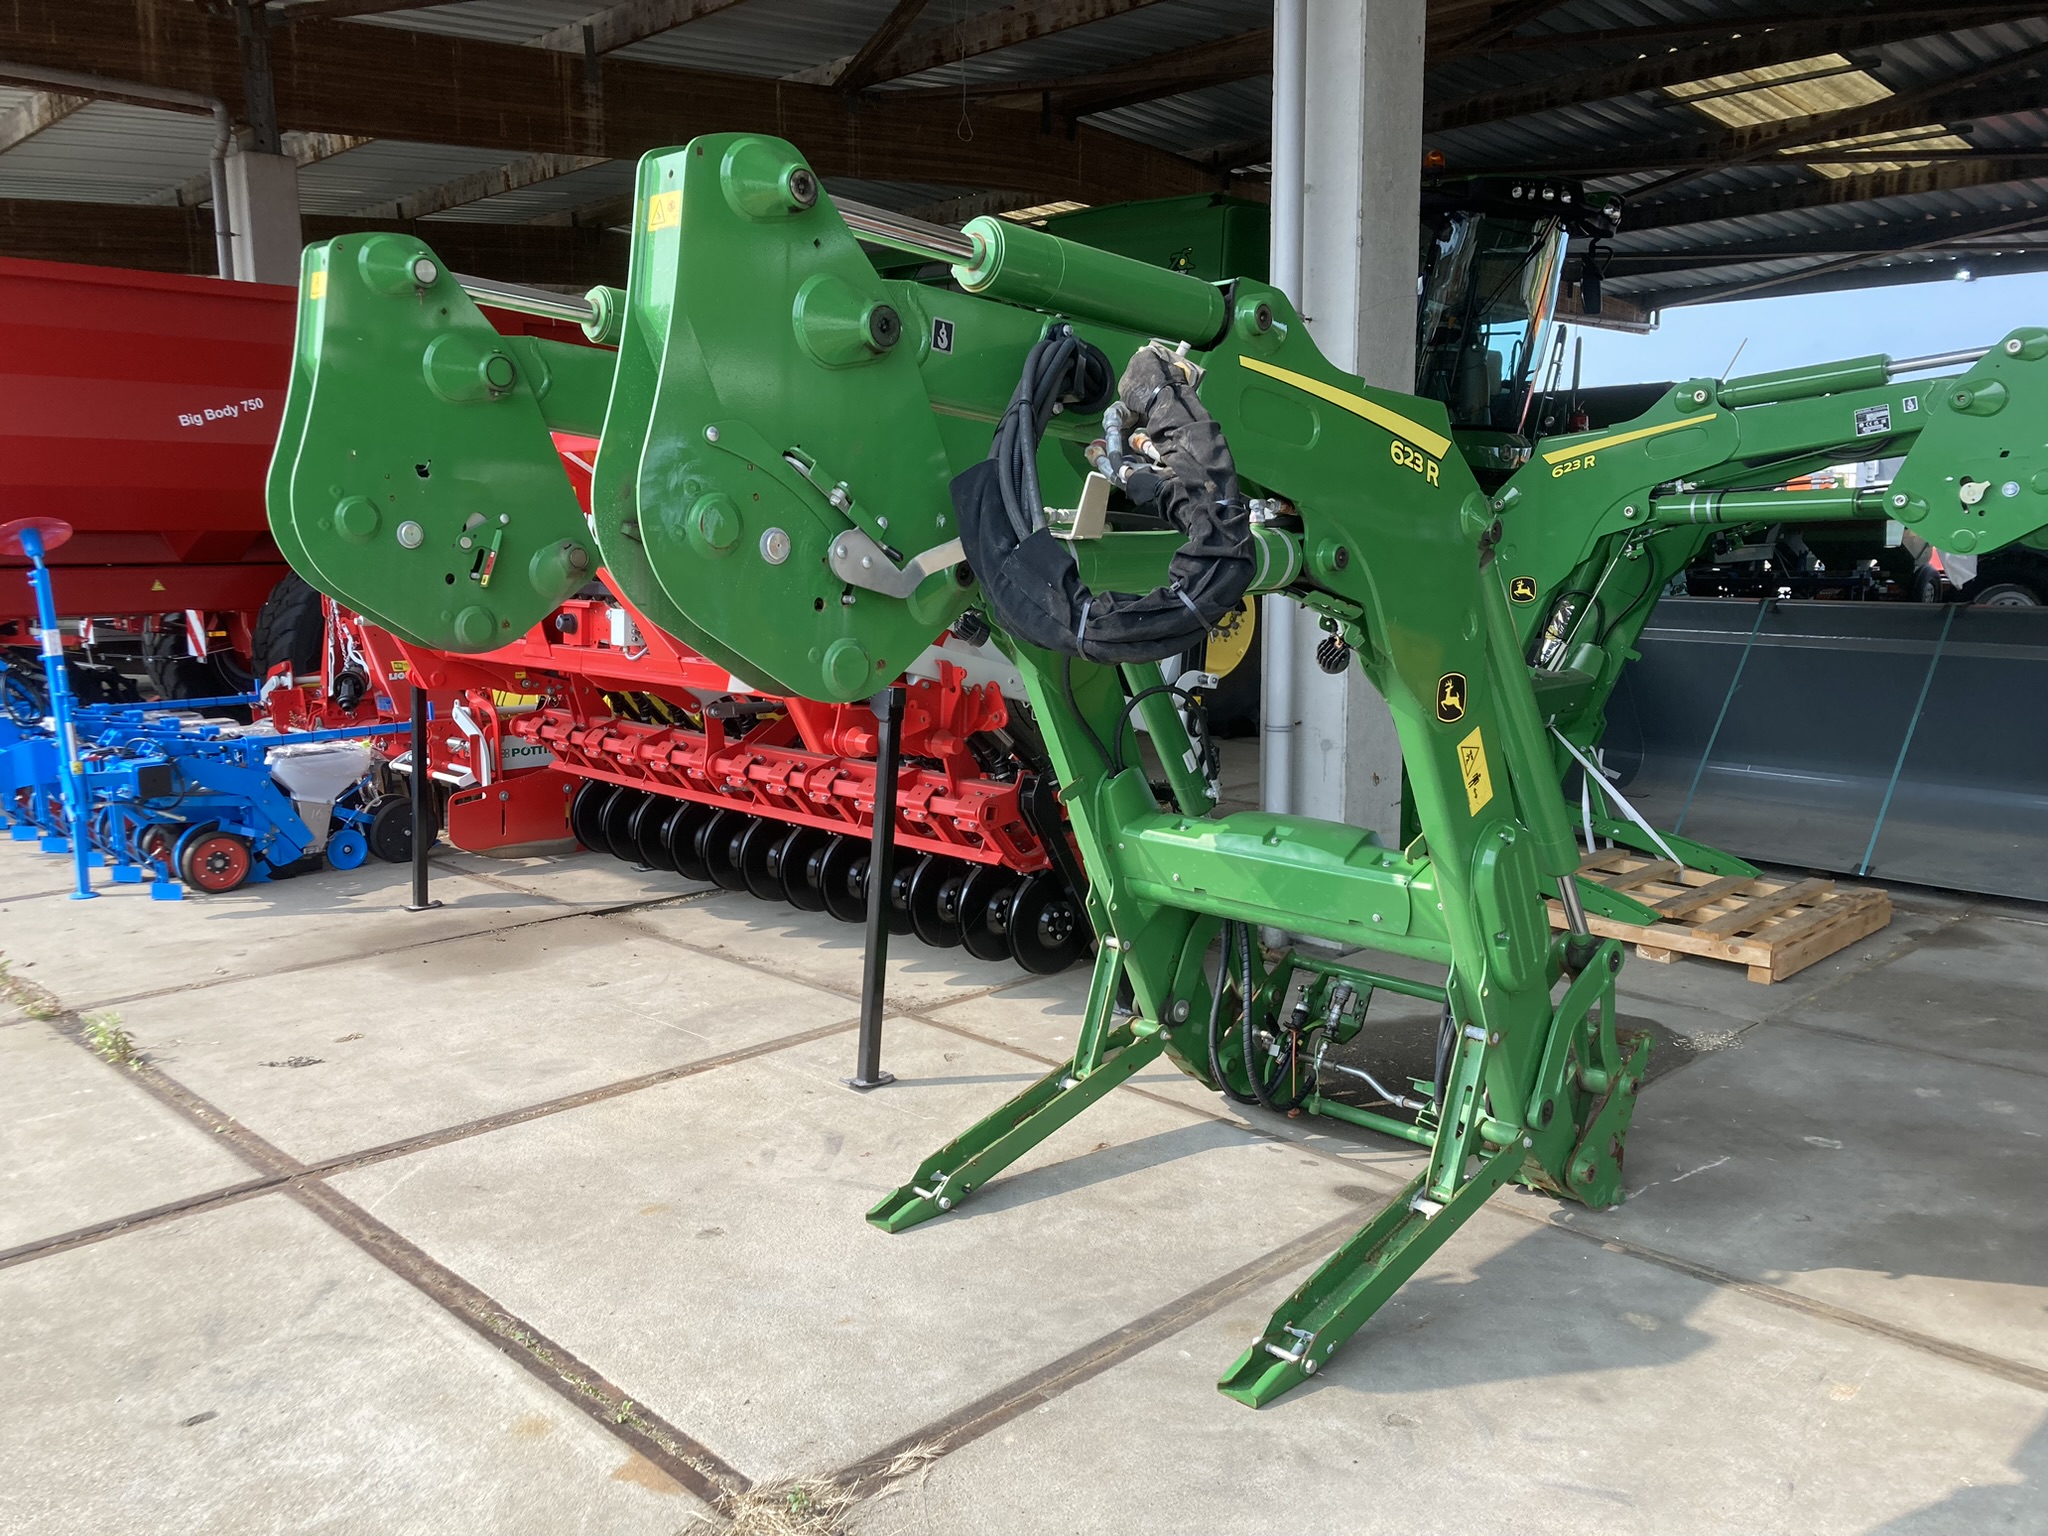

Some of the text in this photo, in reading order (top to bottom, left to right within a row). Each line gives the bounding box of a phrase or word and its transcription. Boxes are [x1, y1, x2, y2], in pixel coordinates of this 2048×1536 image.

[178, 397, 264, 427] Big Body 750
[1390, 439, 1440, 489] 623 R
[1551, 454, 1597, 479] 623 R
[511, 745, 552, 758] PÖTTI
